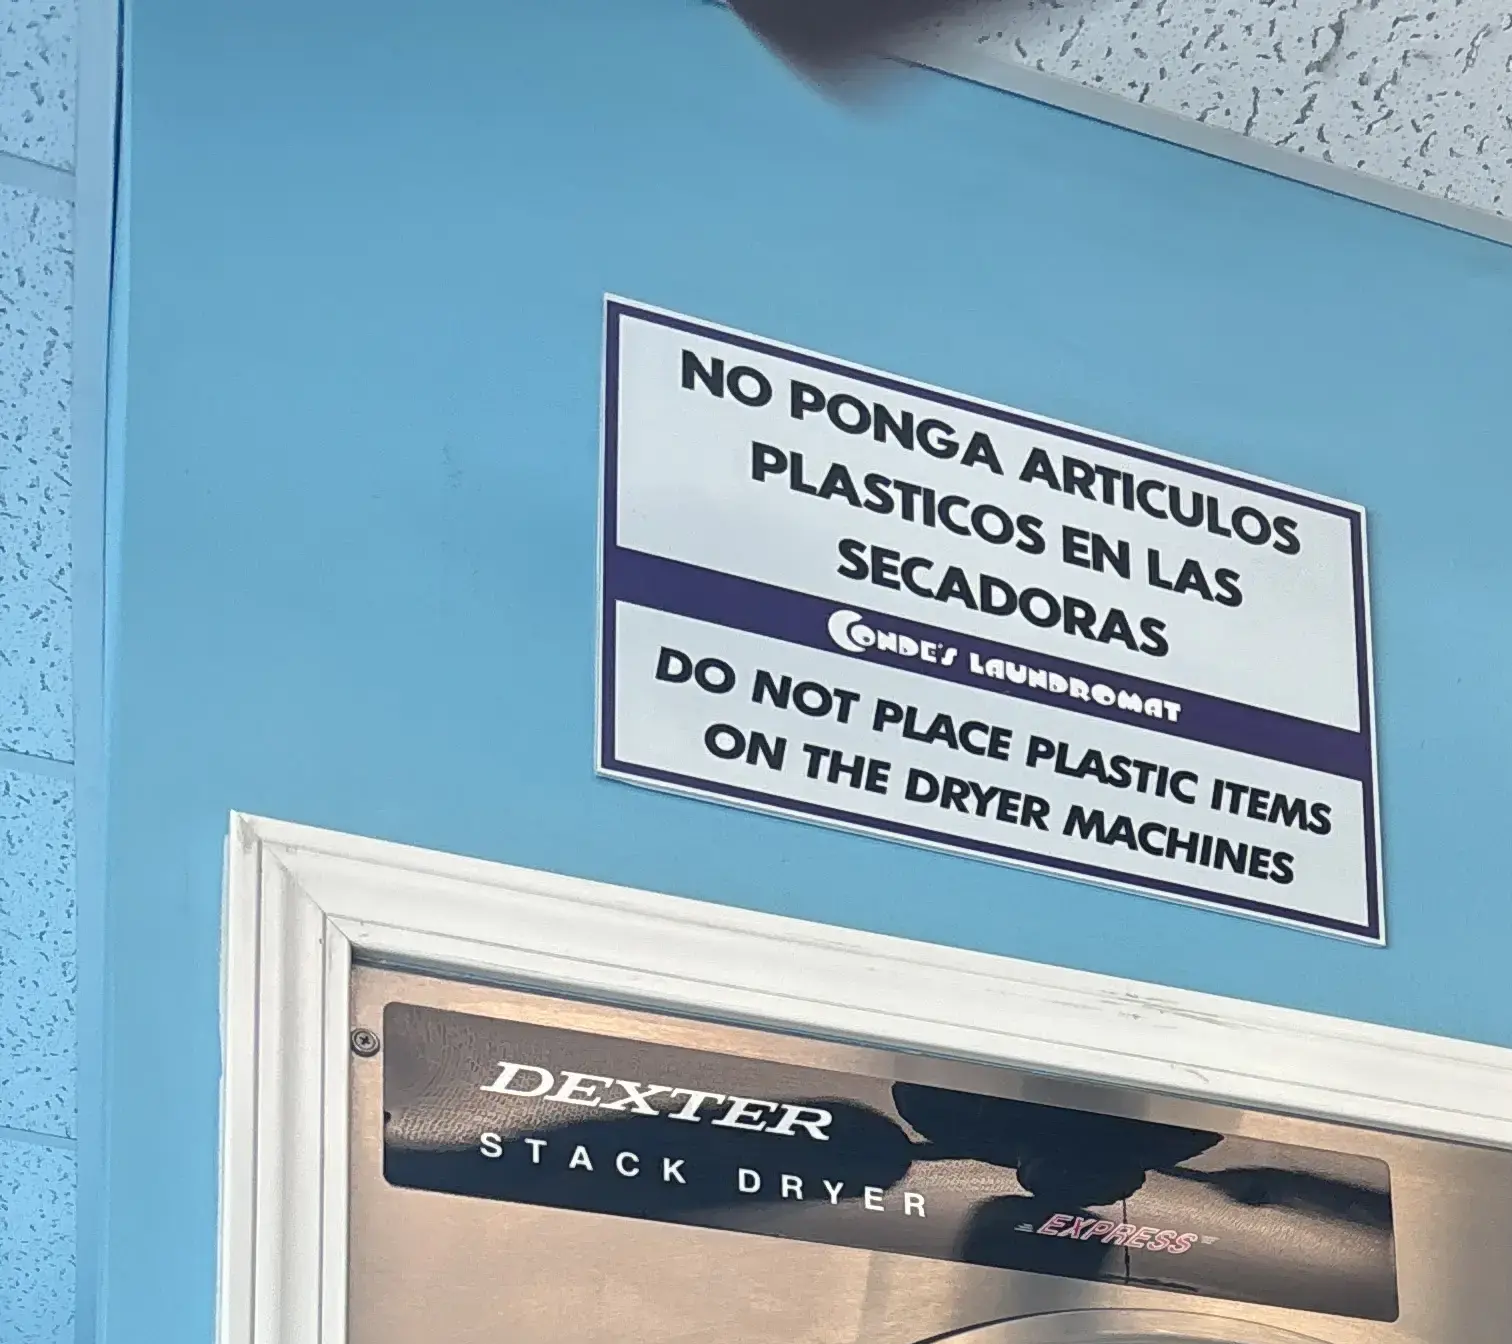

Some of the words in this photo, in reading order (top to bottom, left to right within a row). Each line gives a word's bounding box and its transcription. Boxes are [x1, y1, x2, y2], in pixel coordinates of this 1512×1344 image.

[681, 349, 772, 406] NO
[791, 379, 1004, 475] PONGA
[1020, 448, 1301, 556] ARTICULOS
[752, 441, 1045, 555] PLASTICOS
[1062, 525, 1130, 579] EN
[1148, 552, 1242, 607] LAS
[838, 539, 1168, 657] SECADORAS
[656, 647, 735, 693] DO
[753, 670, 860, 724] NOT
[873, 699, 1010, 761] PLACE
[1027, 736, 1198, 804] PLASTIC
[1212, 780, 1331, 836] ITEMS
[970, 653, 1181, 722] LAUNDROMAT
[705, 724, 786, 770] ON
[804, 743, 891, 793] THE
[906, 768, 1050, 830] DRYER
[1063, 807, 1294, 884] MACHINES
[479, 1061, 834, 1142] DEXTER
[479, 1131, 687, 1185] STACK
[739, 1166, 928, 1219] DRYER
[1037, 1214, 1198, 1254] EXPRESS
